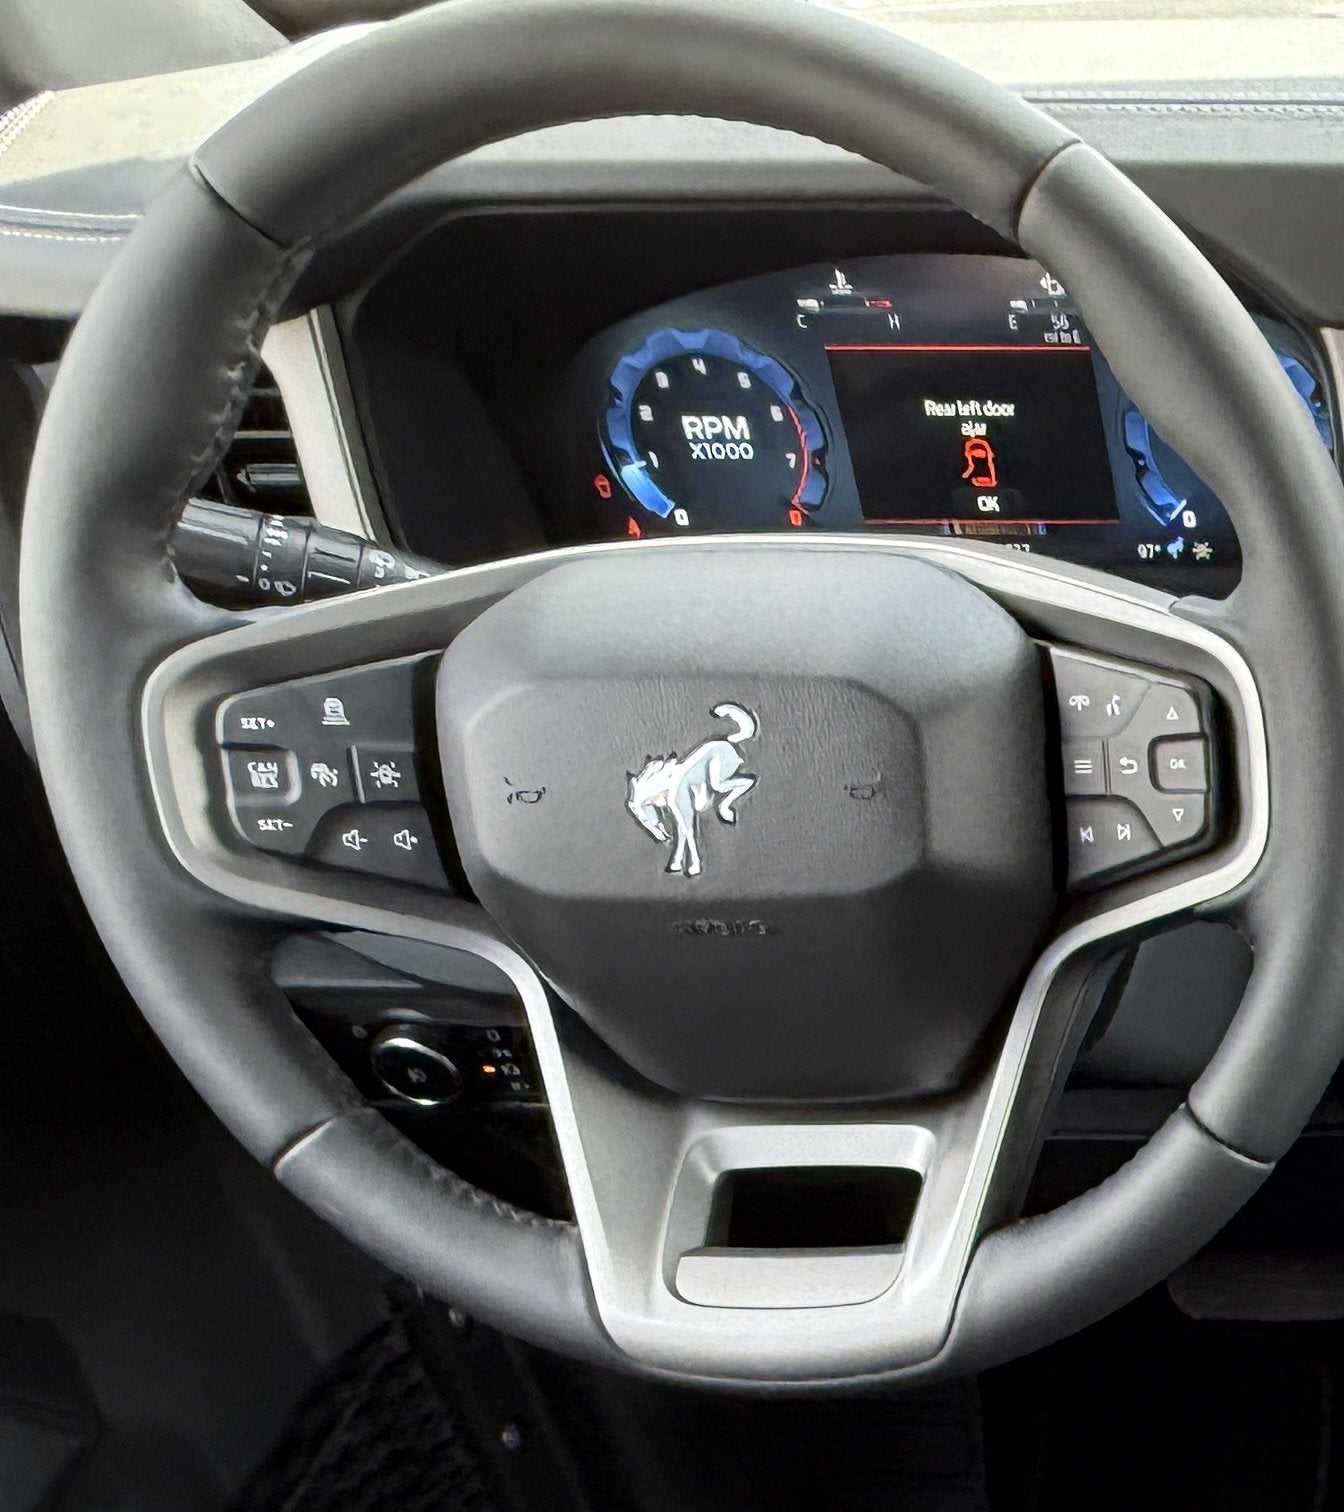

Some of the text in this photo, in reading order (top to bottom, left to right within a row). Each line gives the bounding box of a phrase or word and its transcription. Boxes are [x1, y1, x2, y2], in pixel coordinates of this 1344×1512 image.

[692, 358, 707, 375] 4
[924, 400, 1015, 416] Rear left door
[681, 415, 751, 440] RPM
[689, 442, 754, 460] X1000
[977, 496, 999, 512] OK
[674, 508, 689, 526] 0
[1183, 510, 1197, 528] 0
[1169, 758, 1187, 770] OK
